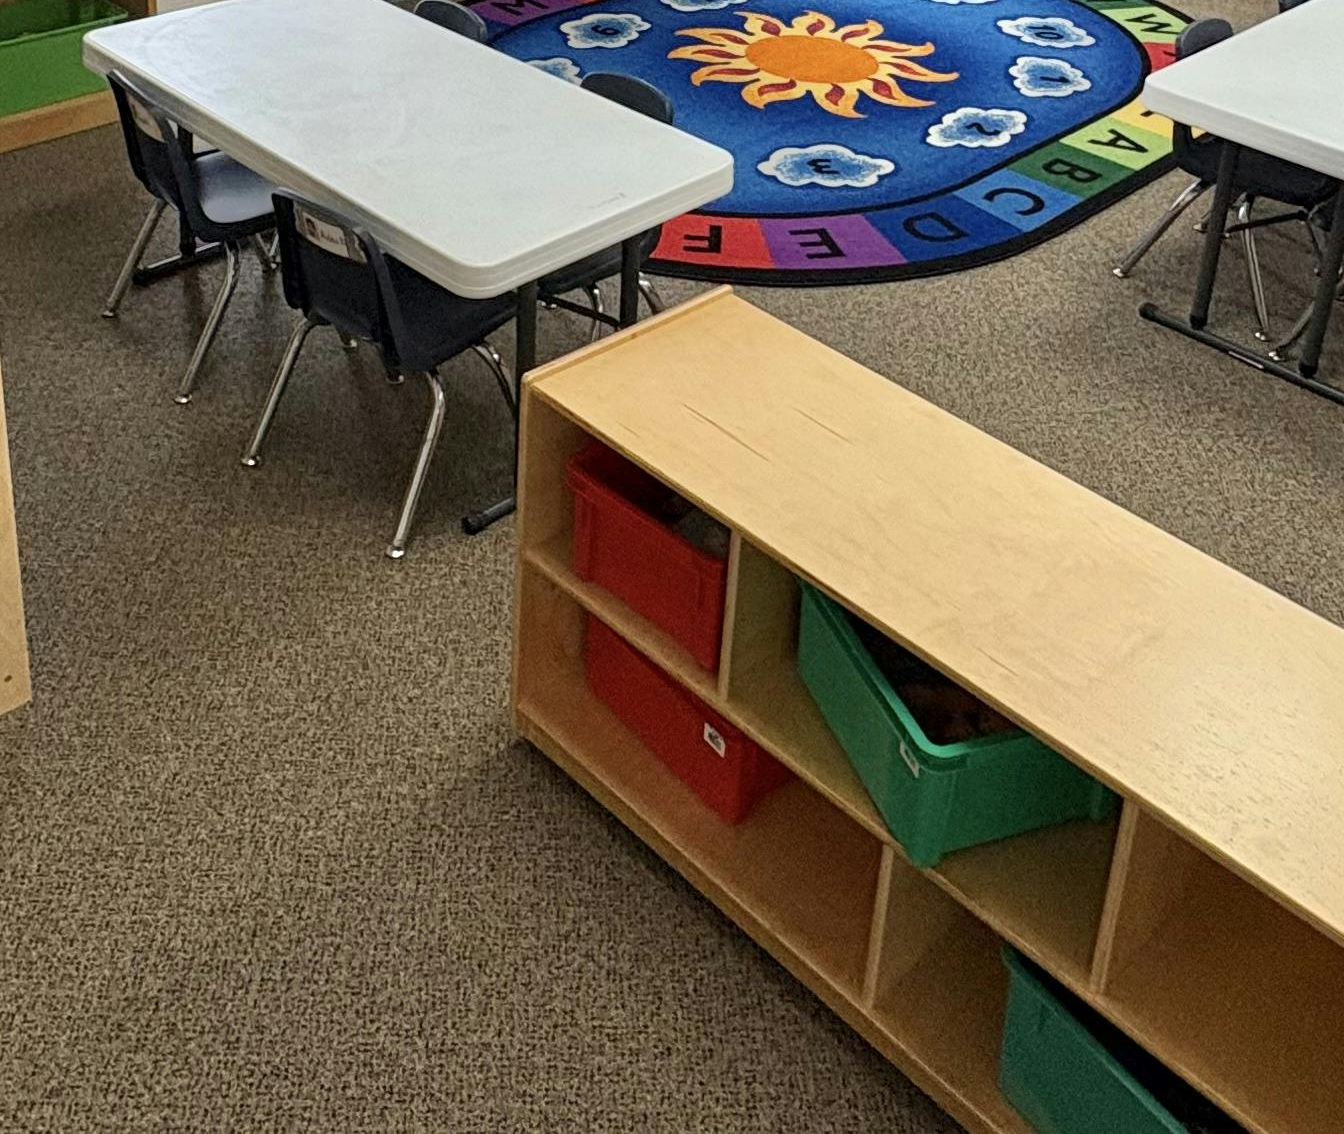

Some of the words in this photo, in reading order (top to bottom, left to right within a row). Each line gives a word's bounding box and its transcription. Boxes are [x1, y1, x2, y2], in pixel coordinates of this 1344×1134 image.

[1088, 128, 1149, 154] A
[1041, 157, 1104, 184] B
[983, 187, 1046, 216] C
[683, 225, 723, 254] F
[902, 211, 970, 243] D
[788, 226, 847, 260] E
